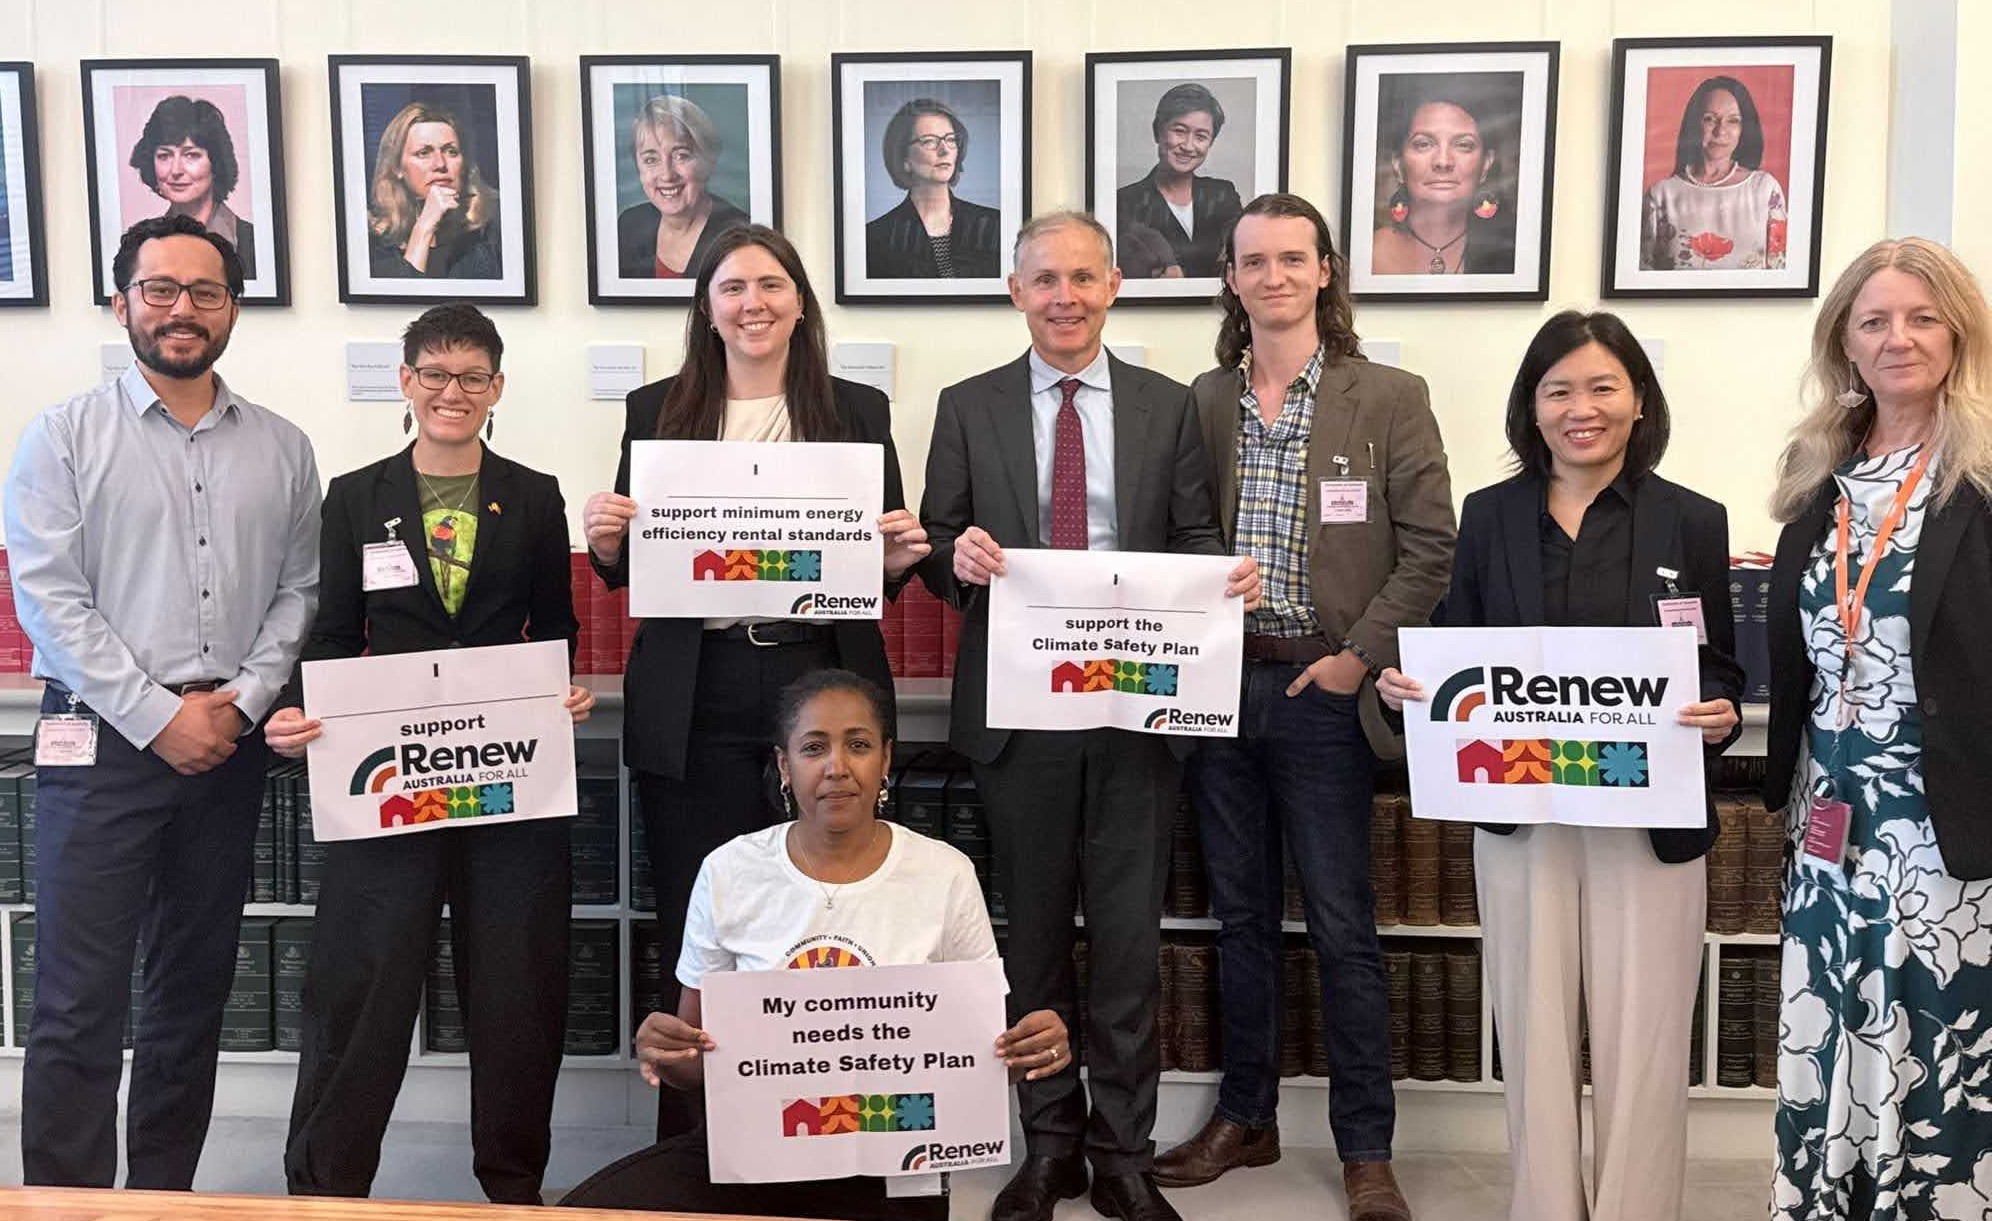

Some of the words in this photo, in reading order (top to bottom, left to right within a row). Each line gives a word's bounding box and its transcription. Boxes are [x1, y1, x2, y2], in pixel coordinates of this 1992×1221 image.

[753, 464, 758, 475] I
[651, 506, 717, 521] support
[722, 506, 800, 519] minimum
[806, 507, 864, 522] energy
[642, 527, 727, 543] efficiency
[732, 528, 782, 540] rental
[788, 529, 872, 541] standards
[1113, 573, 1118, 585] I
[815, 593, 878, 609] Renew
[1065, 618, 1130, 632] support
[1135, 619, 1163, 632] the
[1032, 638, 1099, 652] Climate
[1103, 638, 1157, 656] Safety
[1162, 642, 1200, 656] Plan
[433, 662, 439, 678] I
[1491, 666, 1669, 707] Renew
[400, 714, 486, 737] support
[1169, 708, 1234, 726] Renew
[1493, 710, 1584, 724] AUSTRALIA
[1590, 712, 1624, 725] FOR
[1626, 712, 1656, 725] ALL
[401, 738, 538, 775] Renew
[403, 773, 475, 790] AUSTRALIA
[479, 769, 505, 782] FOR
[506, 767, 528, 779] ALL
[785, 934, 828, 957] COMMUNITY
[833, 935, 854, 946] FAITH
[763, 997, 797, 1017] My
[804, 992, 938, 1012] community
[792, 1023, 864, 1044] needs
[872, 1023, 911, 1040] the
[737, 1056, 831, 1077] Climate
[839, 1055, 916, 1074] Safety
[923, 1052, 975, 1069] Plan
[928, 1140, 1004, 1161] Renew
